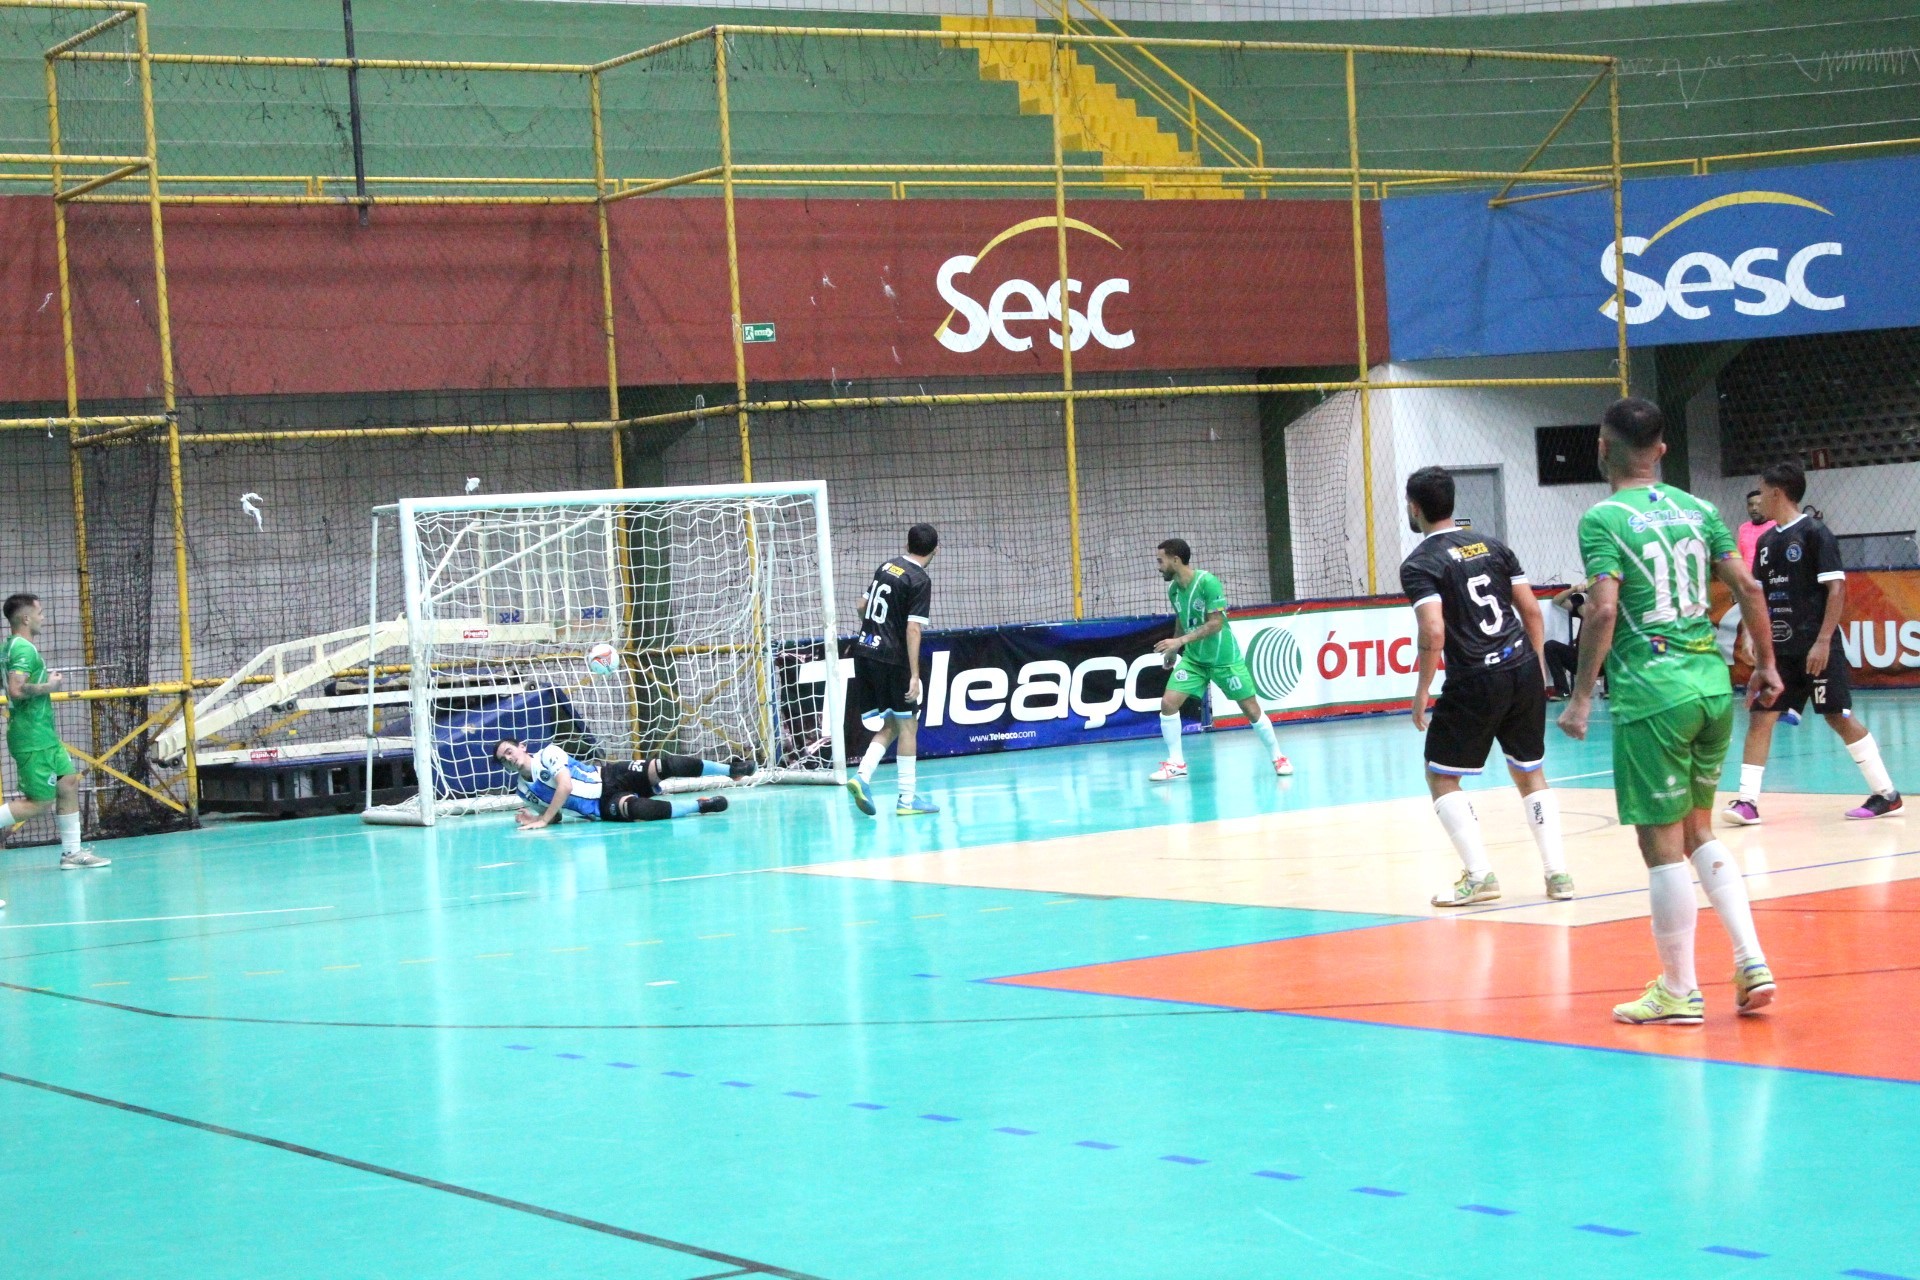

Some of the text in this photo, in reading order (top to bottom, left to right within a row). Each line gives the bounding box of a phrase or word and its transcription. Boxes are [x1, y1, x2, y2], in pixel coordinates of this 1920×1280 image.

[935, 254, 1136, 353] Sesc
[1600, 236, 1846, 325] Sesc
[865, 579, 892, 624] 16
[1467, 573, 1503, 636] 5
[1642, 536, 1712, 624] 10
[798, 650, 1182, 737] Tleaço
[1227, 675, 1243, 692] 20
[1814, 685, 1826, 704] 12
